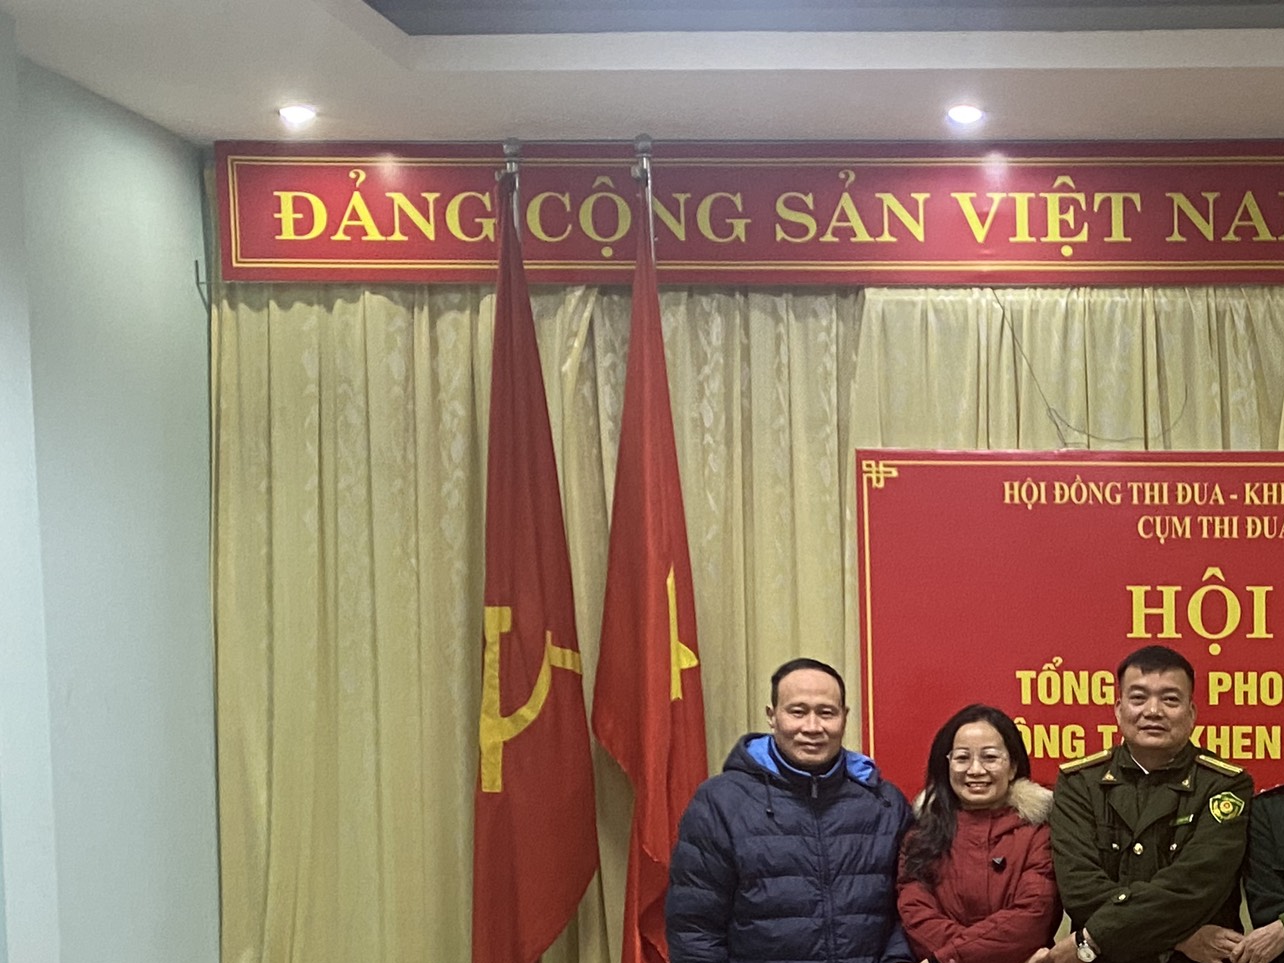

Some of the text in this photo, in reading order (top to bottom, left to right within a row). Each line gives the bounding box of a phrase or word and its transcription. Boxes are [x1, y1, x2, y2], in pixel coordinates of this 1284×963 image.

[274, 169, 496, 242] ĐẢNG
[526, 176, 752, 258] CỘNG
[775, 170, 930, 243] SẢN
[951, 175, 1141, 257] VIỆT
[1003, 478, 1048, 510] HỘI
[1053, 474, 1122, 505] ĐỒNG
[1128, 481, 1169, 505] THI
[1176, 481, 1226, 505] ĐUA
[1137, 515, 1192, 544] CỤM
[1197, 515, 1239, 539] THI
[1126, 566, 1273, 656] HỘI
[1015, 656, 1115, 706] TỔNG
